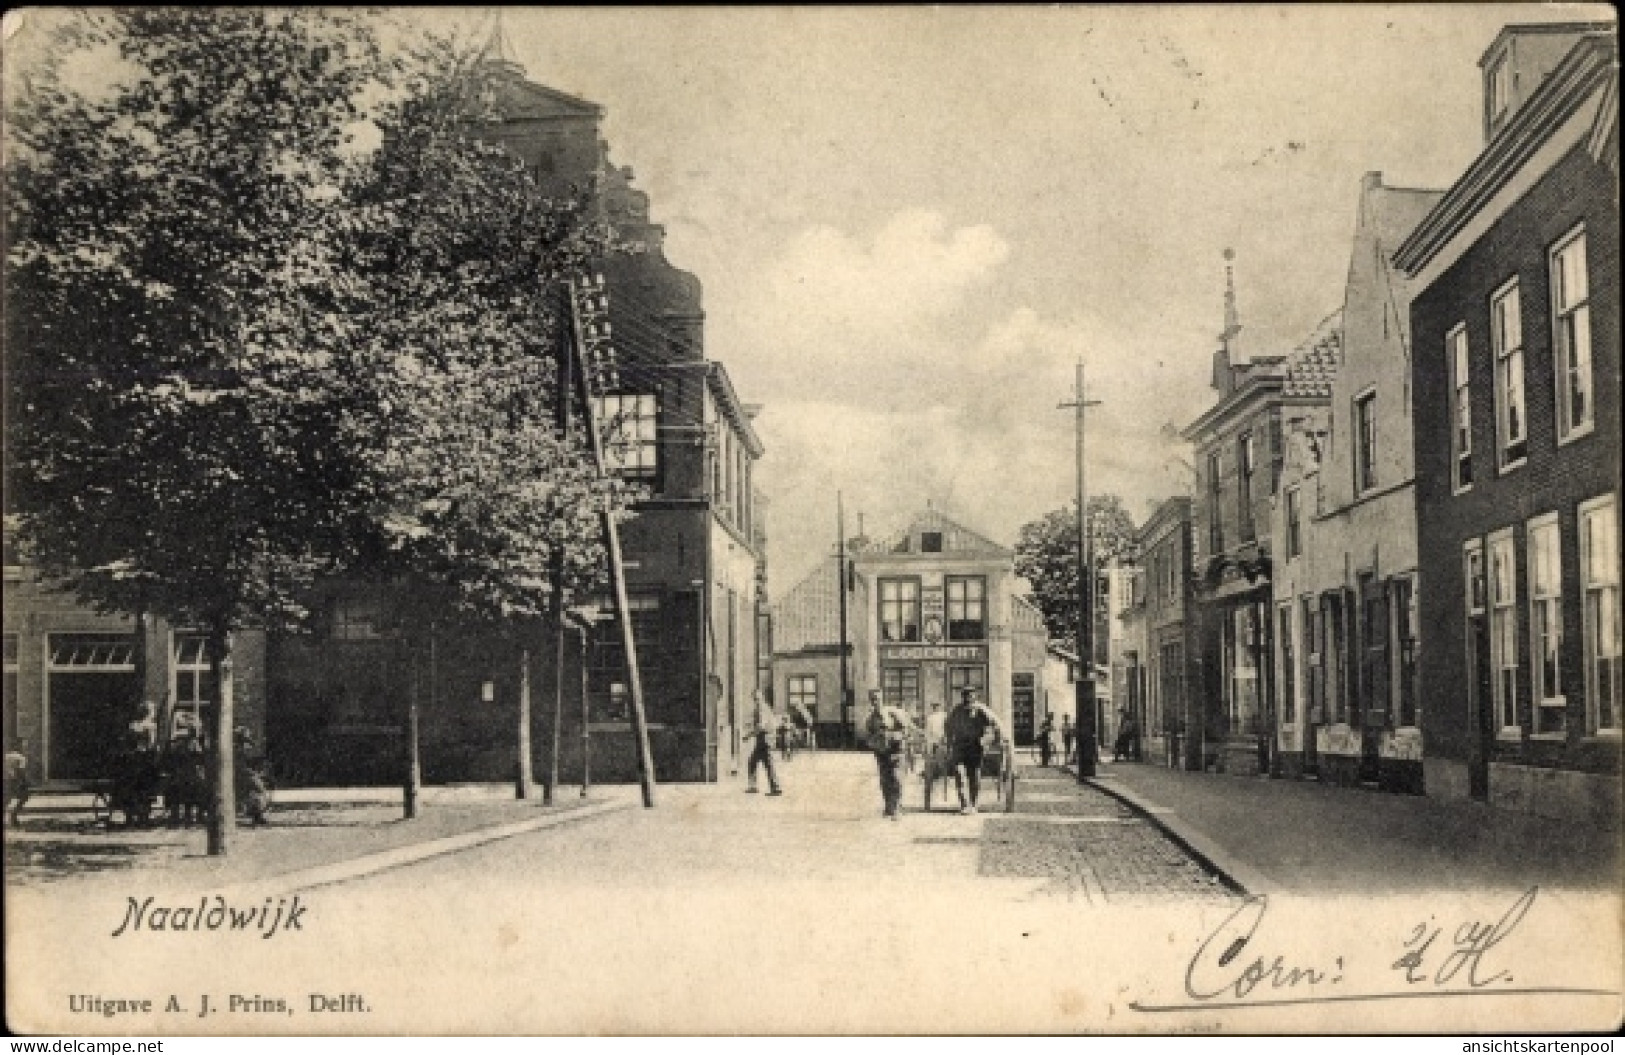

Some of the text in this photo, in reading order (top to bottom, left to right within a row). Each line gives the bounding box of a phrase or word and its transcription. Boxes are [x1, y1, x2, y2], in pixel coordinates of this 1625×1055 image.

[112, 896, 307, 939] Naaldwijk
[69, 994, 371, 1018] Uitgave A. J. Prins, Delft.
